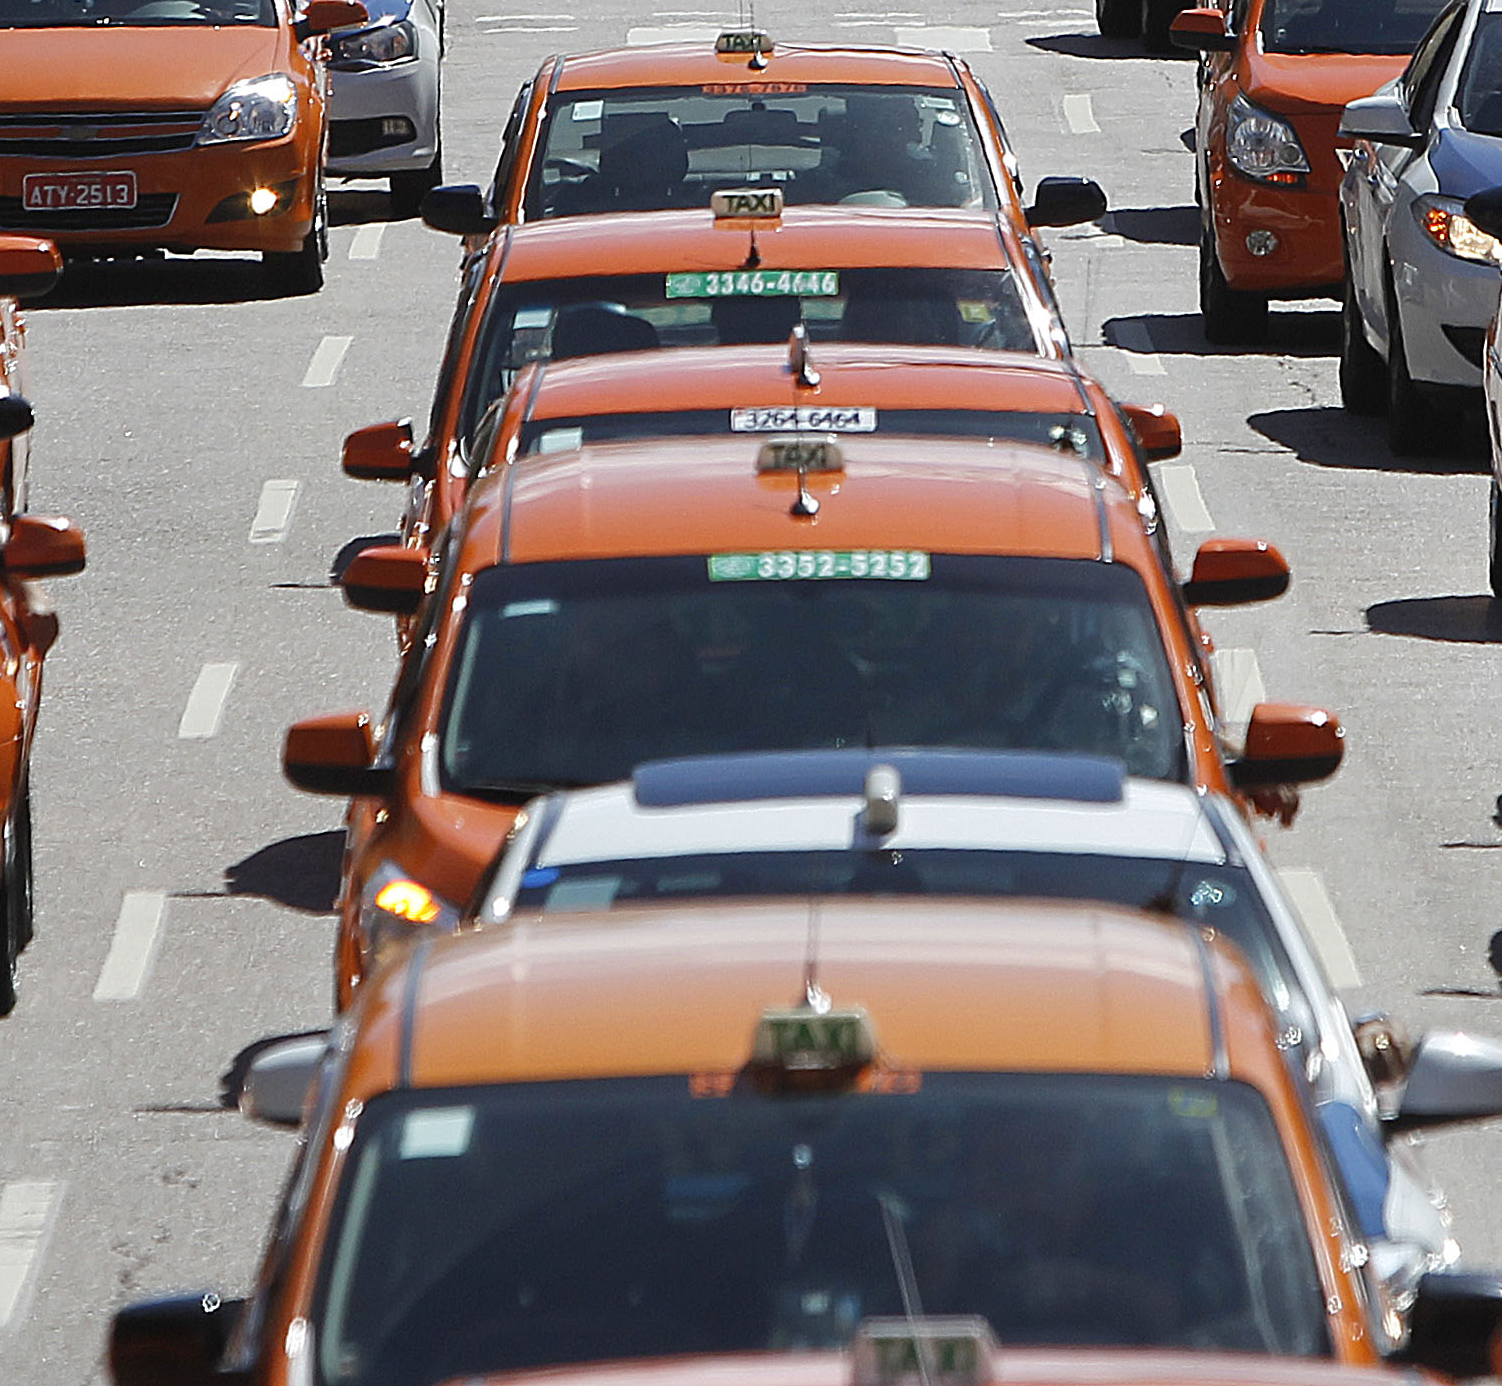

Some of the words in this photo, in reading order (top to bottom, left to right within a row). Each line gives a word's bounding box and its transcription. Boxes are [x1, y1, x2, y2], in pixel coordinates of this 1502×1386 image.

[722, 33, 763, 49] TAXI
[722, 194, 776, 213] TAXI
[706, 272, 836, 295] 3346-4646
[768, 445, 827, 469] TAXI
[758, 552, 928, 578] 3352-5252
[771, 1019, 858, 1054] TAXI
